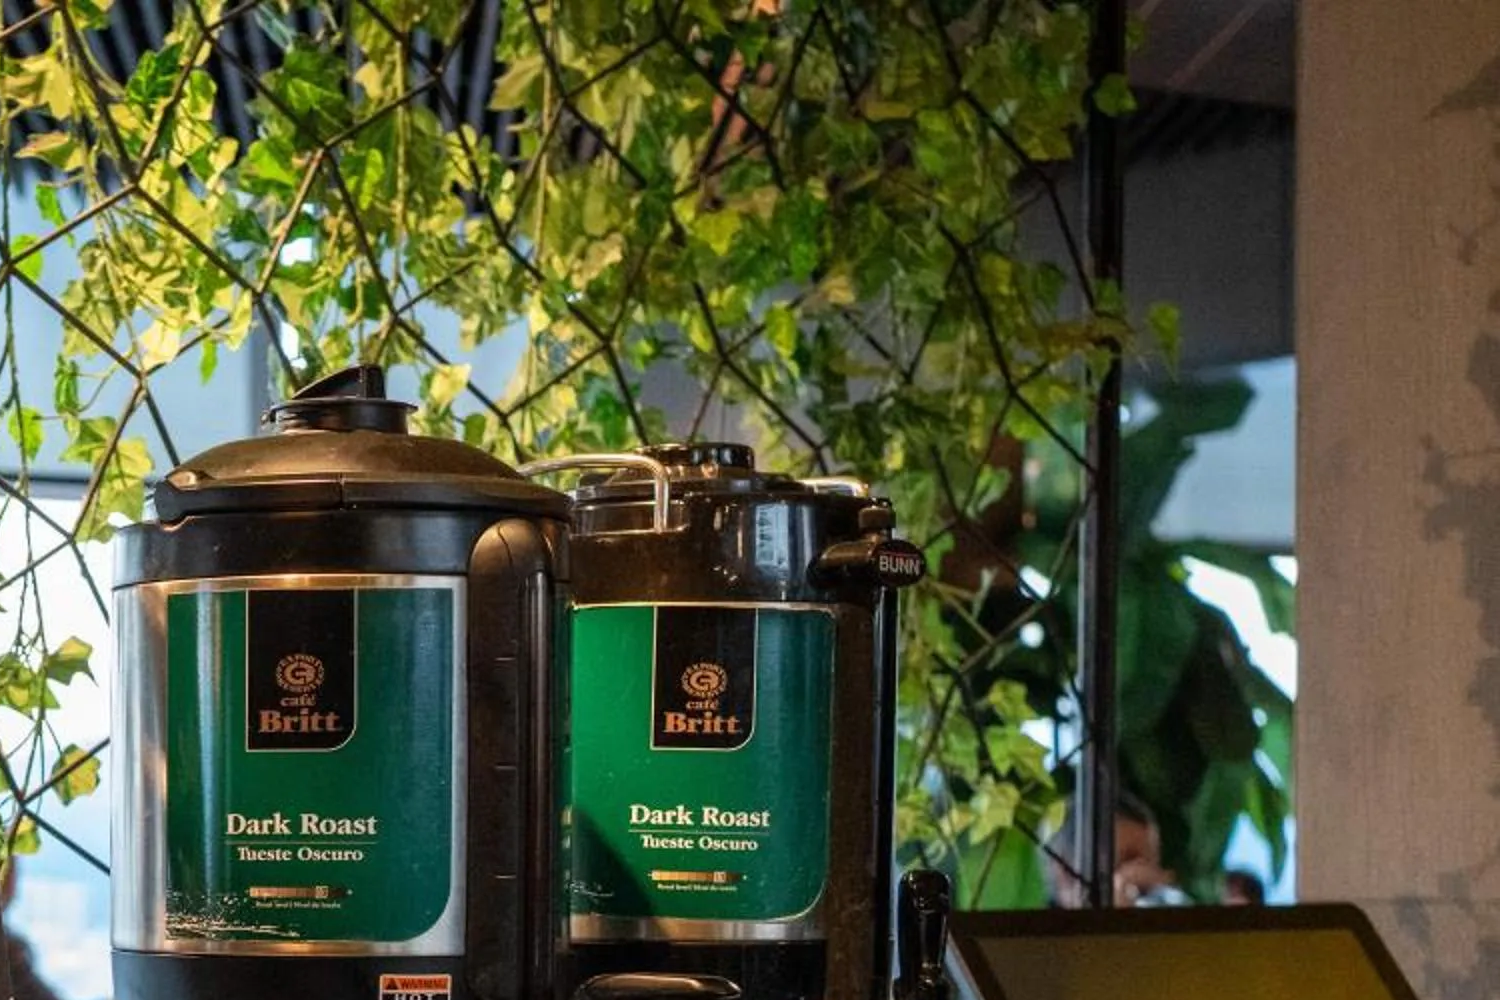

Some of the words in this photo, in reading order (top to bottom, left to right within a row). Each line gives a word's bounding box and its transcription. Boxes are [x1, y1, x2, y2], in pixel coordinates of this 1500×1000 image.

[879, 555, 920, 576] BUNN
[258, 708, 341, 733] Britt
[662, 711, 741, 734] Britt
[225, 811, 292, 835] Dark
[300, 812, 378, 835] Roast
[629, 803, 695, 826] Dark
[701, 806, 771, 828] Roast
[237, 847, 292, 861] Tueste
[297, 846, 364, 861] Oscuro
[640, 834, 695, 849] Tueste
[699, 835, 759, 851] Oscuro
